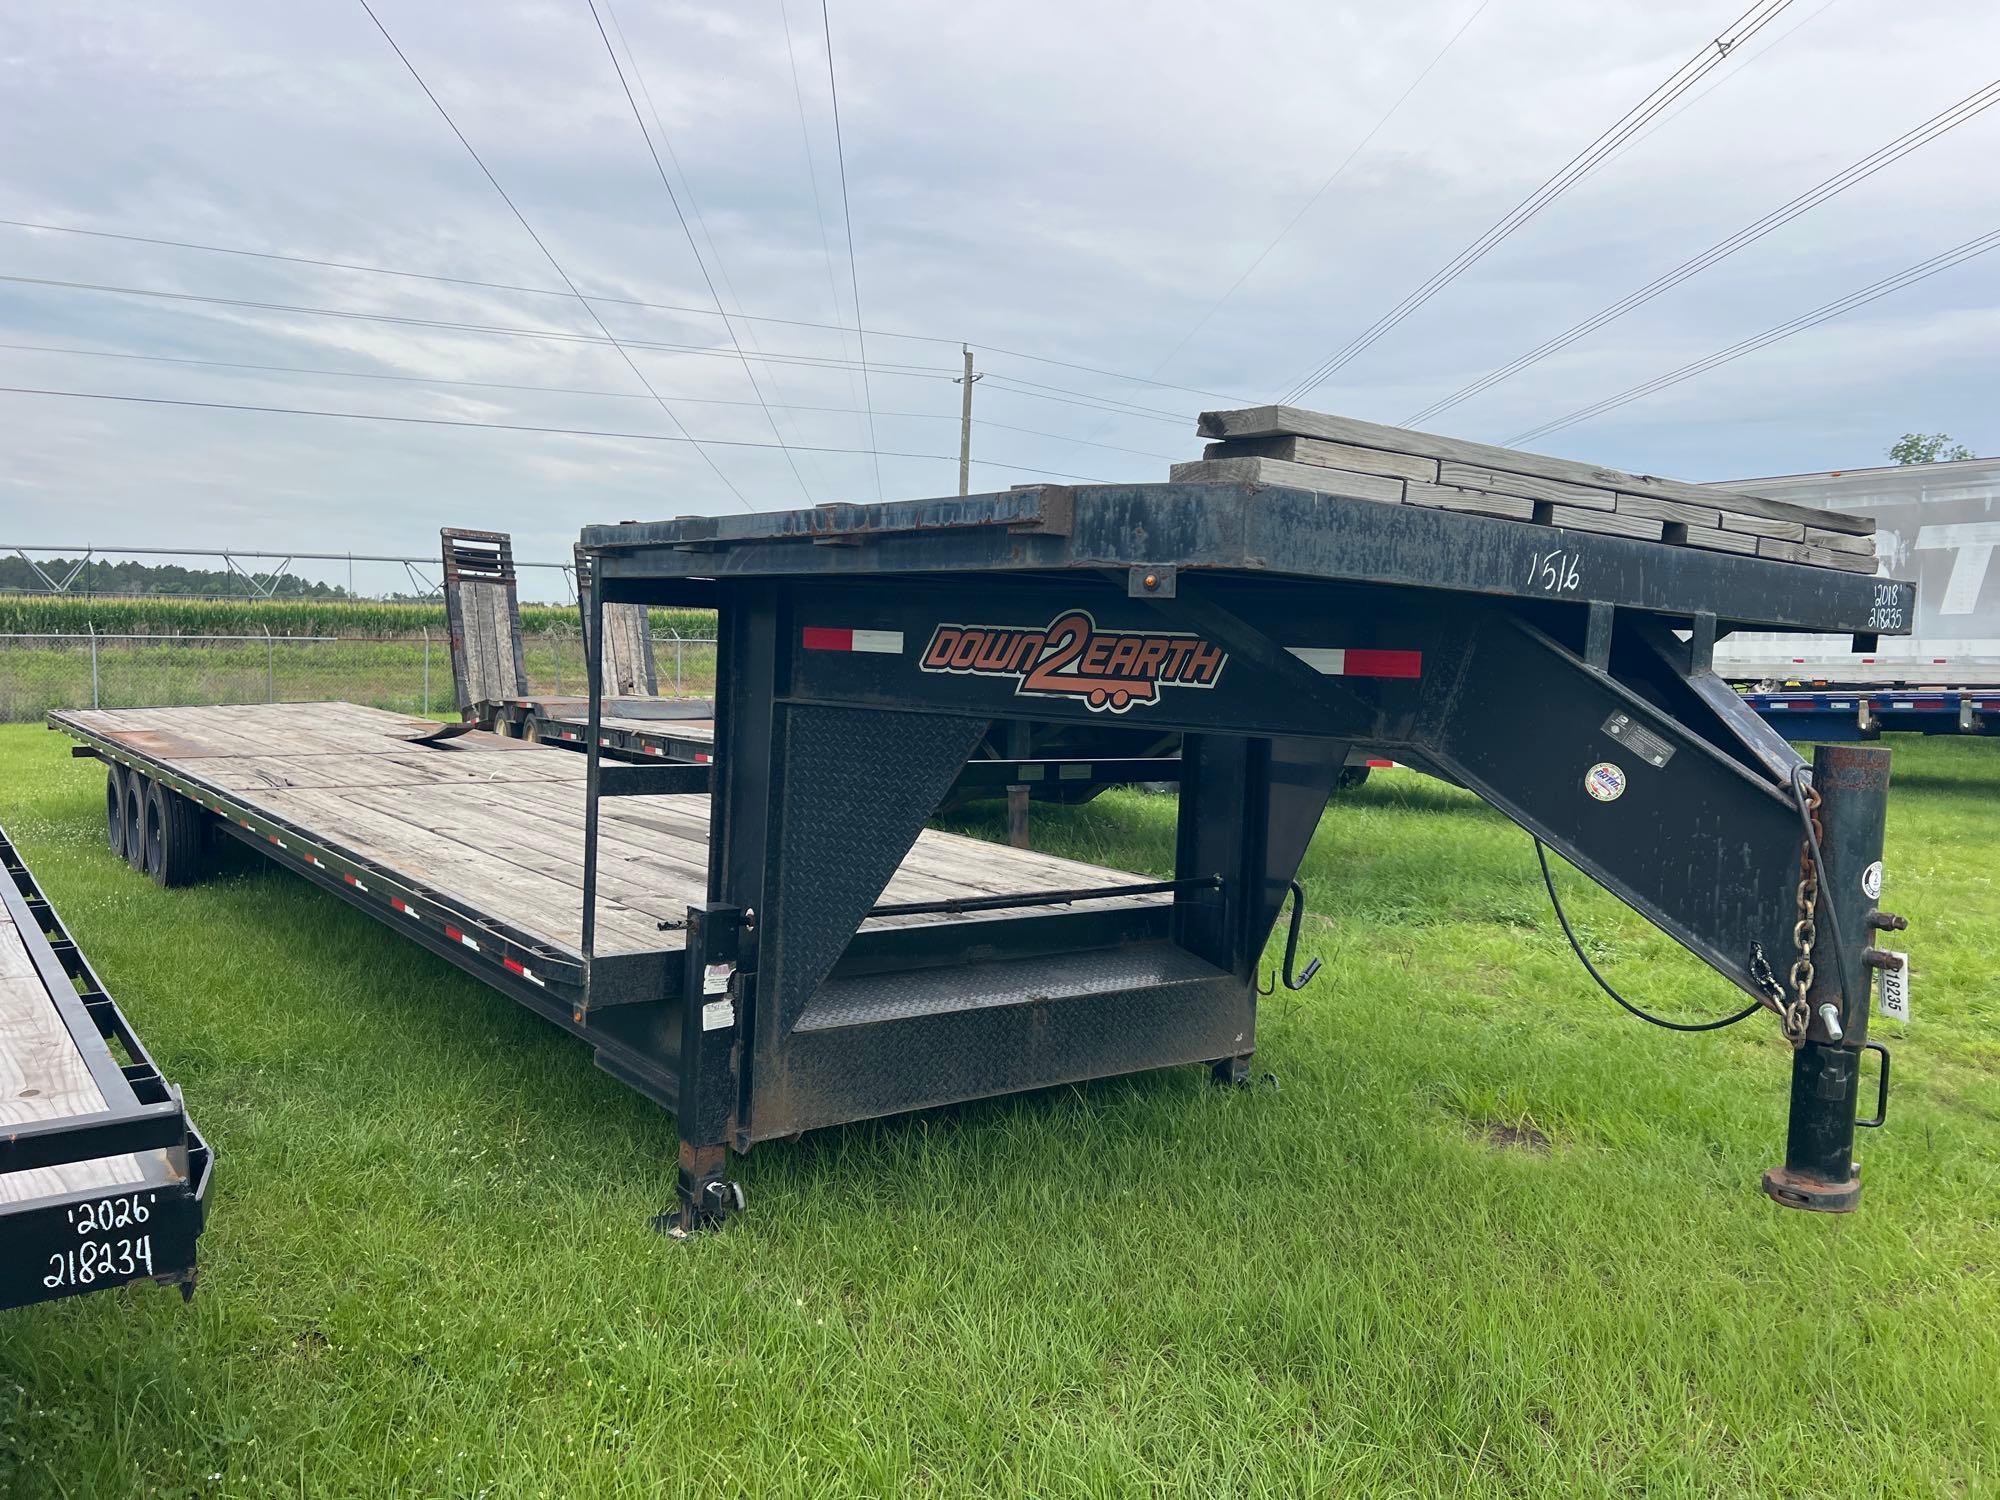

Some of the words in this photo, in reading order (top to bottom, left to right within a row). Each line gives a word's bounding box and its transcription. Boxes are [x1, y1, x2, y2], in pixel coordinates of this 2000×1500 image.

[1527, 549, 1580, 593] 1516
[1867, 607, 1903, 630] 218235
[42, 1234, 153, 1288] 218234
